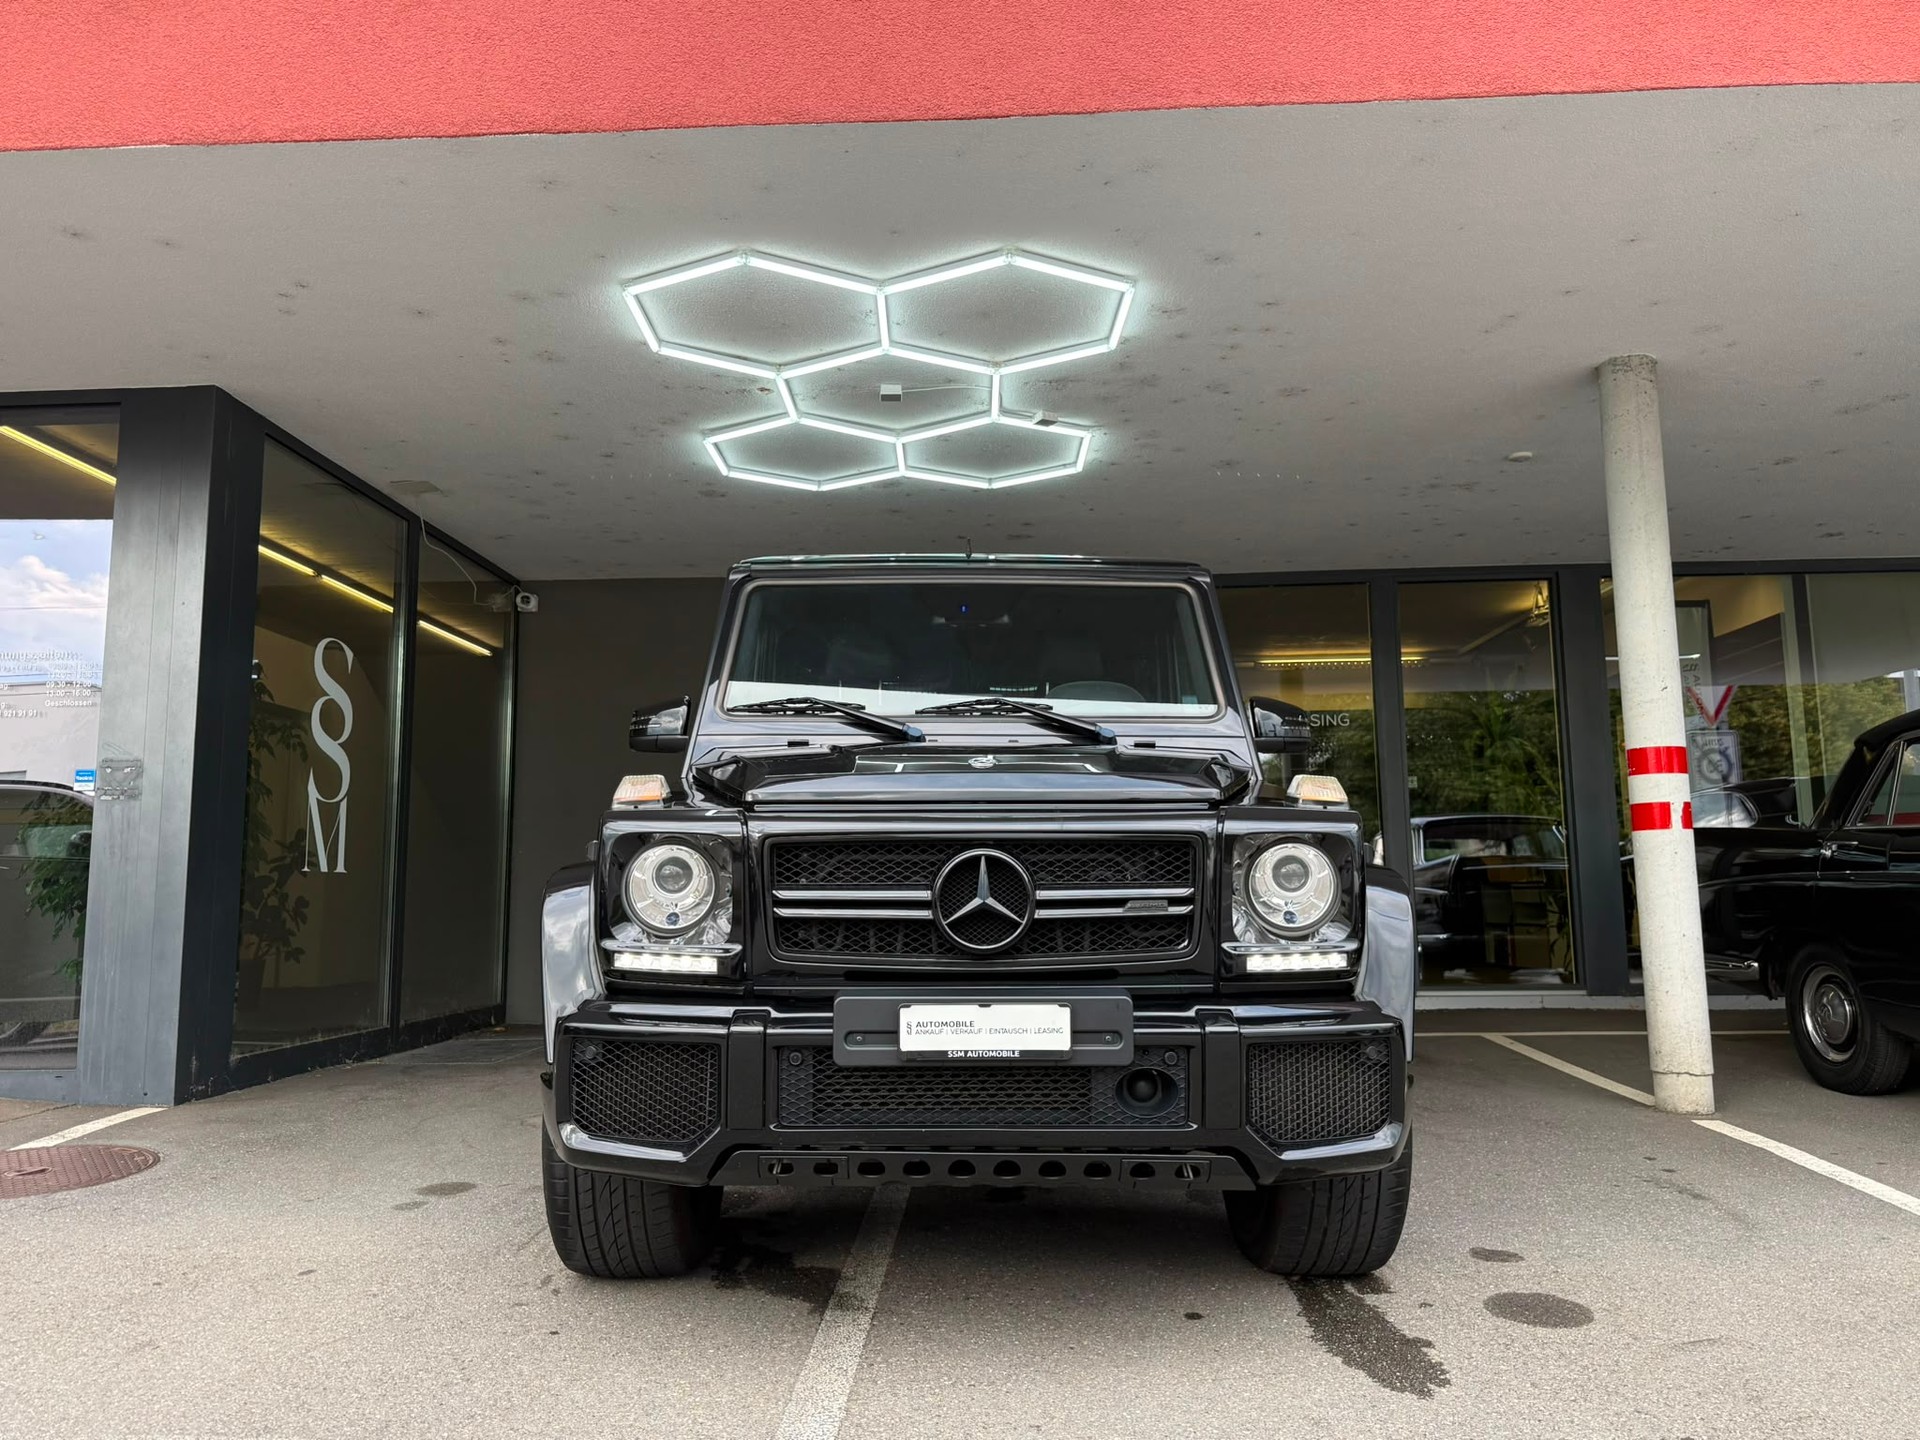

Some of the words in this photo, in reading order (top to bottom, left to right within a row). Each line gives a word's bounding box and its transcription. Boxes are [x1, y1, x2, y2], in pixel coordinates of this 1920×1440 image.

[301, 637, 354, 873] SSM
[916, 1020, 975, 1029] AUTOMOBILE
[989, 1027, 1028, 1035] EINTAUSCH
[947, 1050, 965, 1058] SSM
[966, 1050, 1020, 1058] AUTOMOBILE
